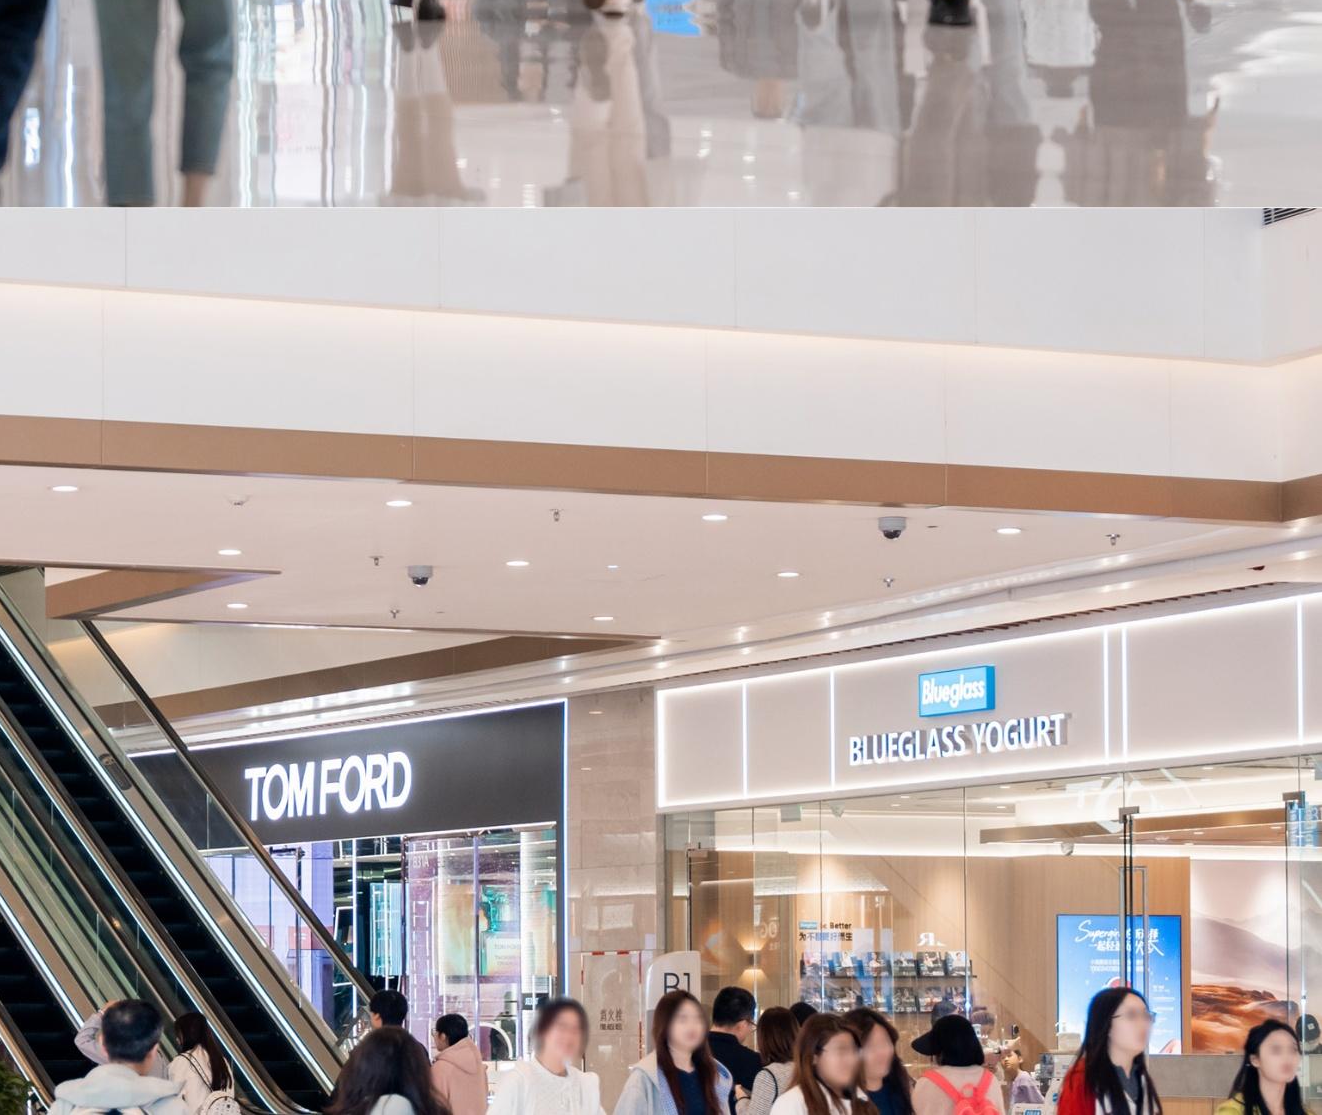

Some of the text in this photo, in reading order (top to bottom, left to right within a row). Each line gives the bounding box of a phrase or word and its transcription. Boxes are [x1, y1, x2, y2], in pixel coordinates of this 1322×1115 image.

[921, 674, 985, 709] Blueglass
[849, 713, 1066, 766] BLUEGLASS YOGURT
[244, 751, 412, 822] TOM FORD
[600, 1007, 623, 1022] 消火栓
